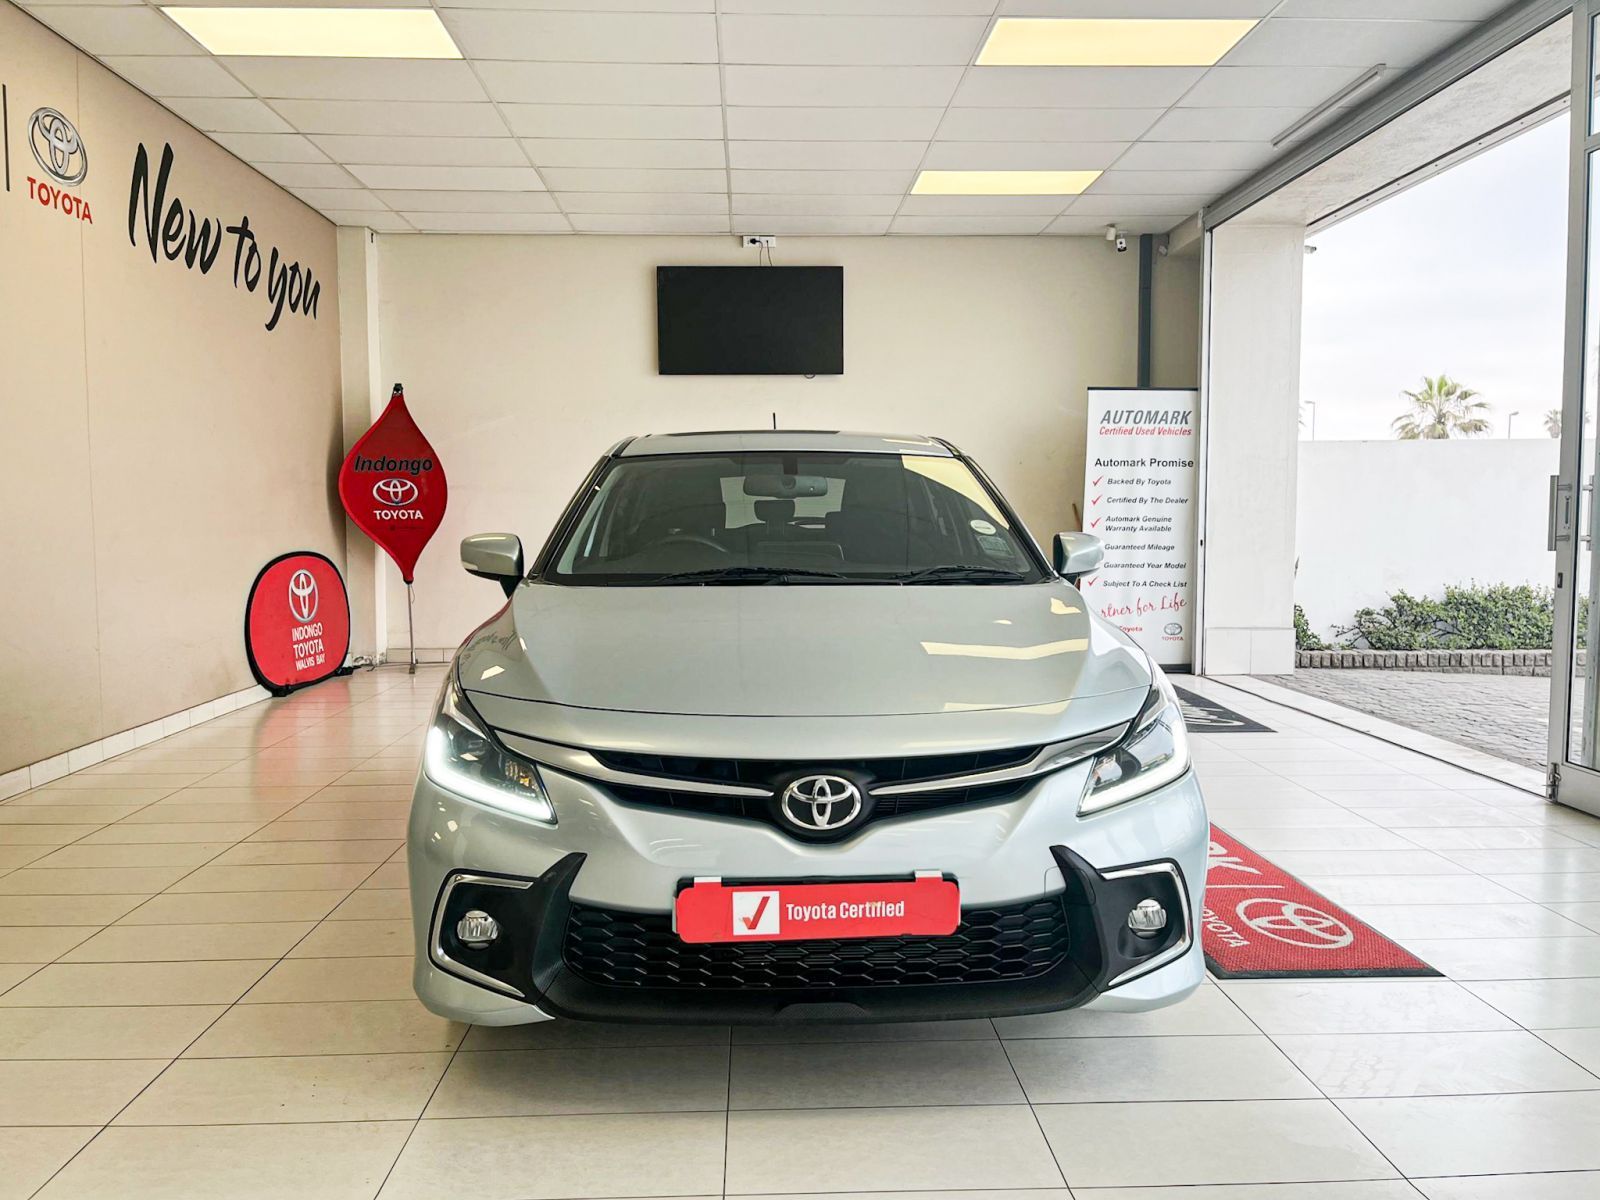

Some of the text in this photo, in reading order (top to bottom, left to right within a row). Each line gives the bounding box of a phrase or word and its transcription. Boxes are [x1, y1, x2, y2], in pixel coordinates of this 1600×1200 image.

[27, 176, 93, 224] TOYOTA
[128, 142, 320, 331] New to you
[1100, 410, 1192, 425] AUTOMARK
[1099, 426, 1192, 436] Certified Used Vehicles
[354, 455, 434, 475] Indongo
[1094, 458, 1194, 468] Automark Promise
[1136, 478, 1145, 486] By
[1147, 478, 1172, 486] Toyota
[1138, 497, 1148, 505] By
[373, 509, 424, 520] TOYOTA
[1105, 525, 1137, 533] Warranty
[1147, 544, 1175, 552] Mileage
[1103, 580, 1130, 588] Subject
[1149, 580, 1171, 588] Check
[1101, 592, 1188, 618] rtner for Life
[291, 622, 323, 641] INDONGO
[293, 638, 324, 659] TOYOTA
[295, 653, 326, 671] WALVIS BAY
[786, 900, 905, 921] Toyota Certified
[1202, 905, 1251, 947] OYOTA
